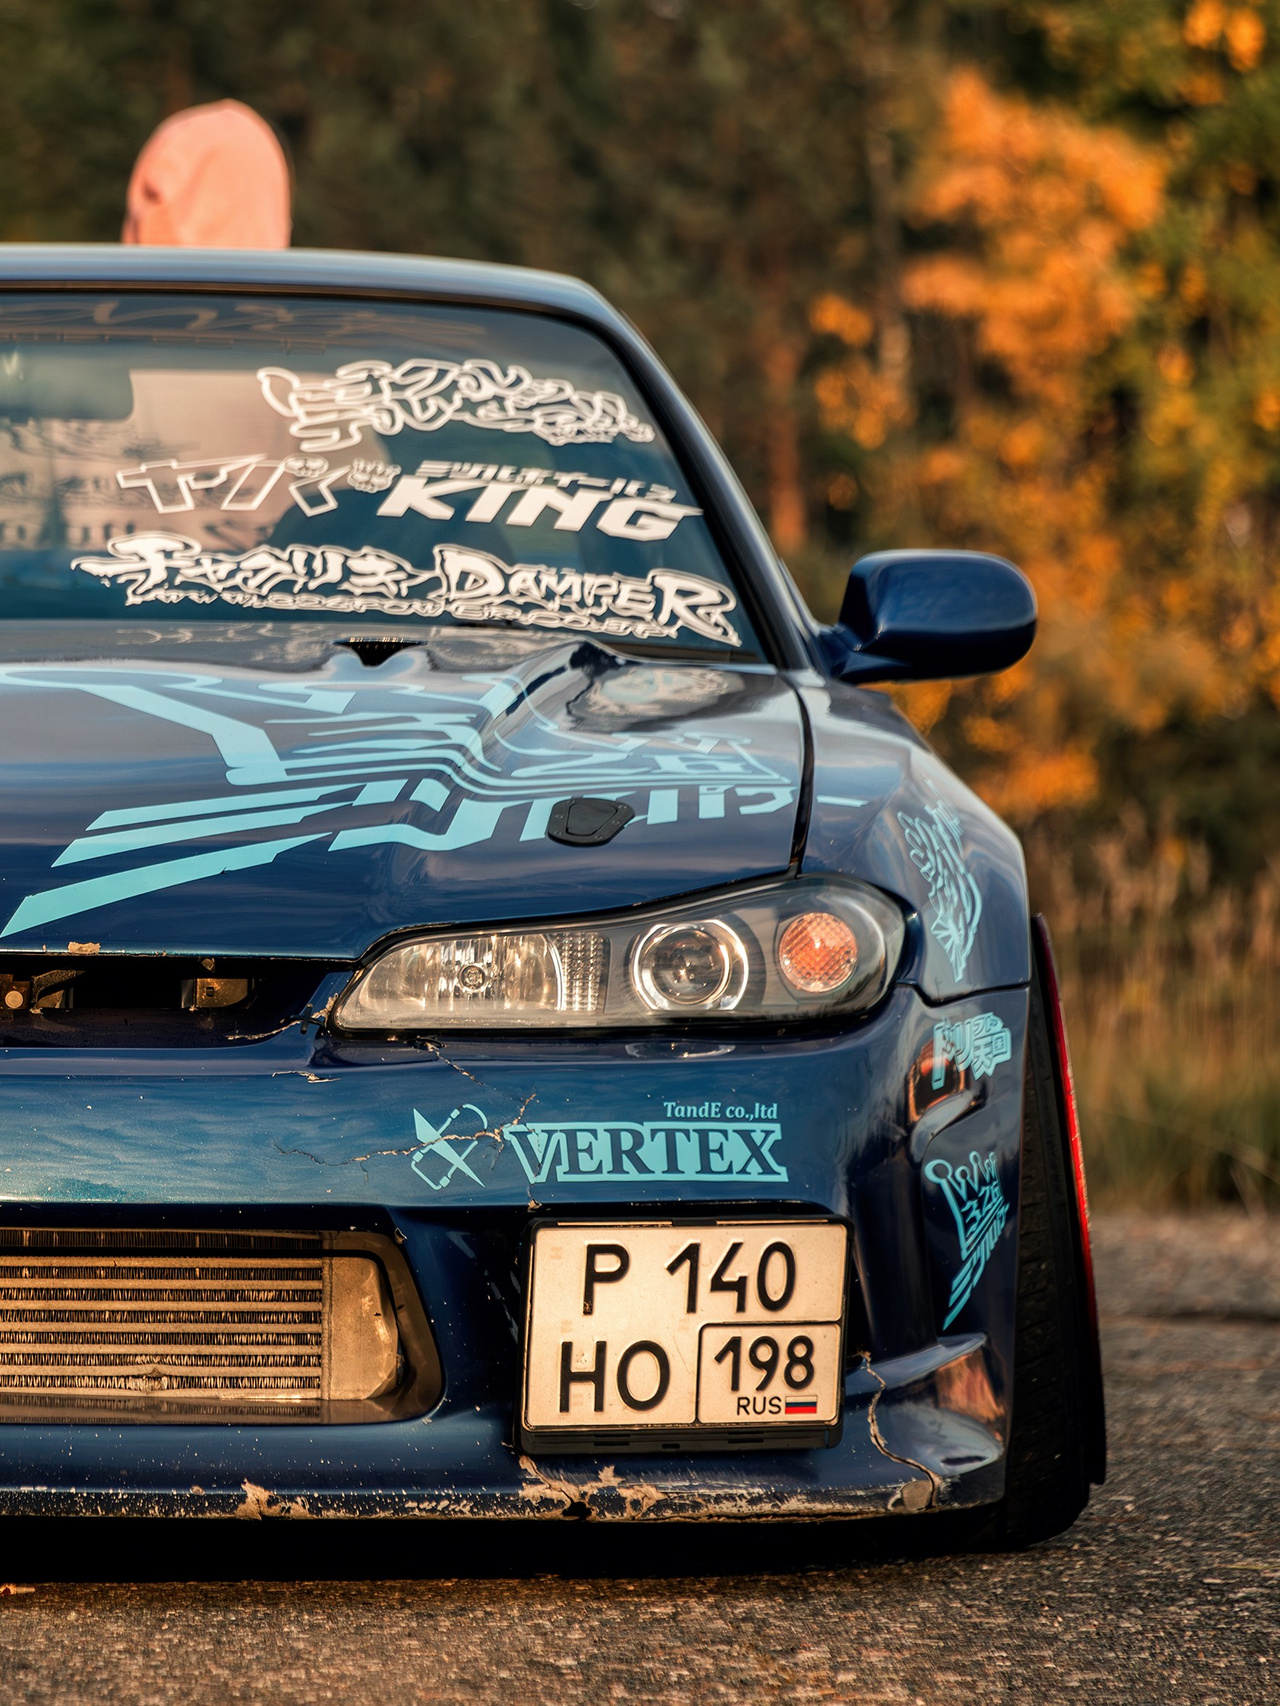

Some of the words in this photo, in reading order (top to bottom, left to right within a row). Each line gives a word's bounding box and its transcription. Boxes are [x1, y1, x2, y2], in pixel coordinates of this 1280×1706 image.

[376, 474, 704, 542] KING
[427, 543, 743, 648] DAMPER
[663, 1101, 722, 1119] TandE
[504, 1121, 790, 1184] VERTEX
[665, 1240, 797, 1315] 140
[713, 1334, 816, 1393] 198
[736, 1396, 782, 1416] RUS
